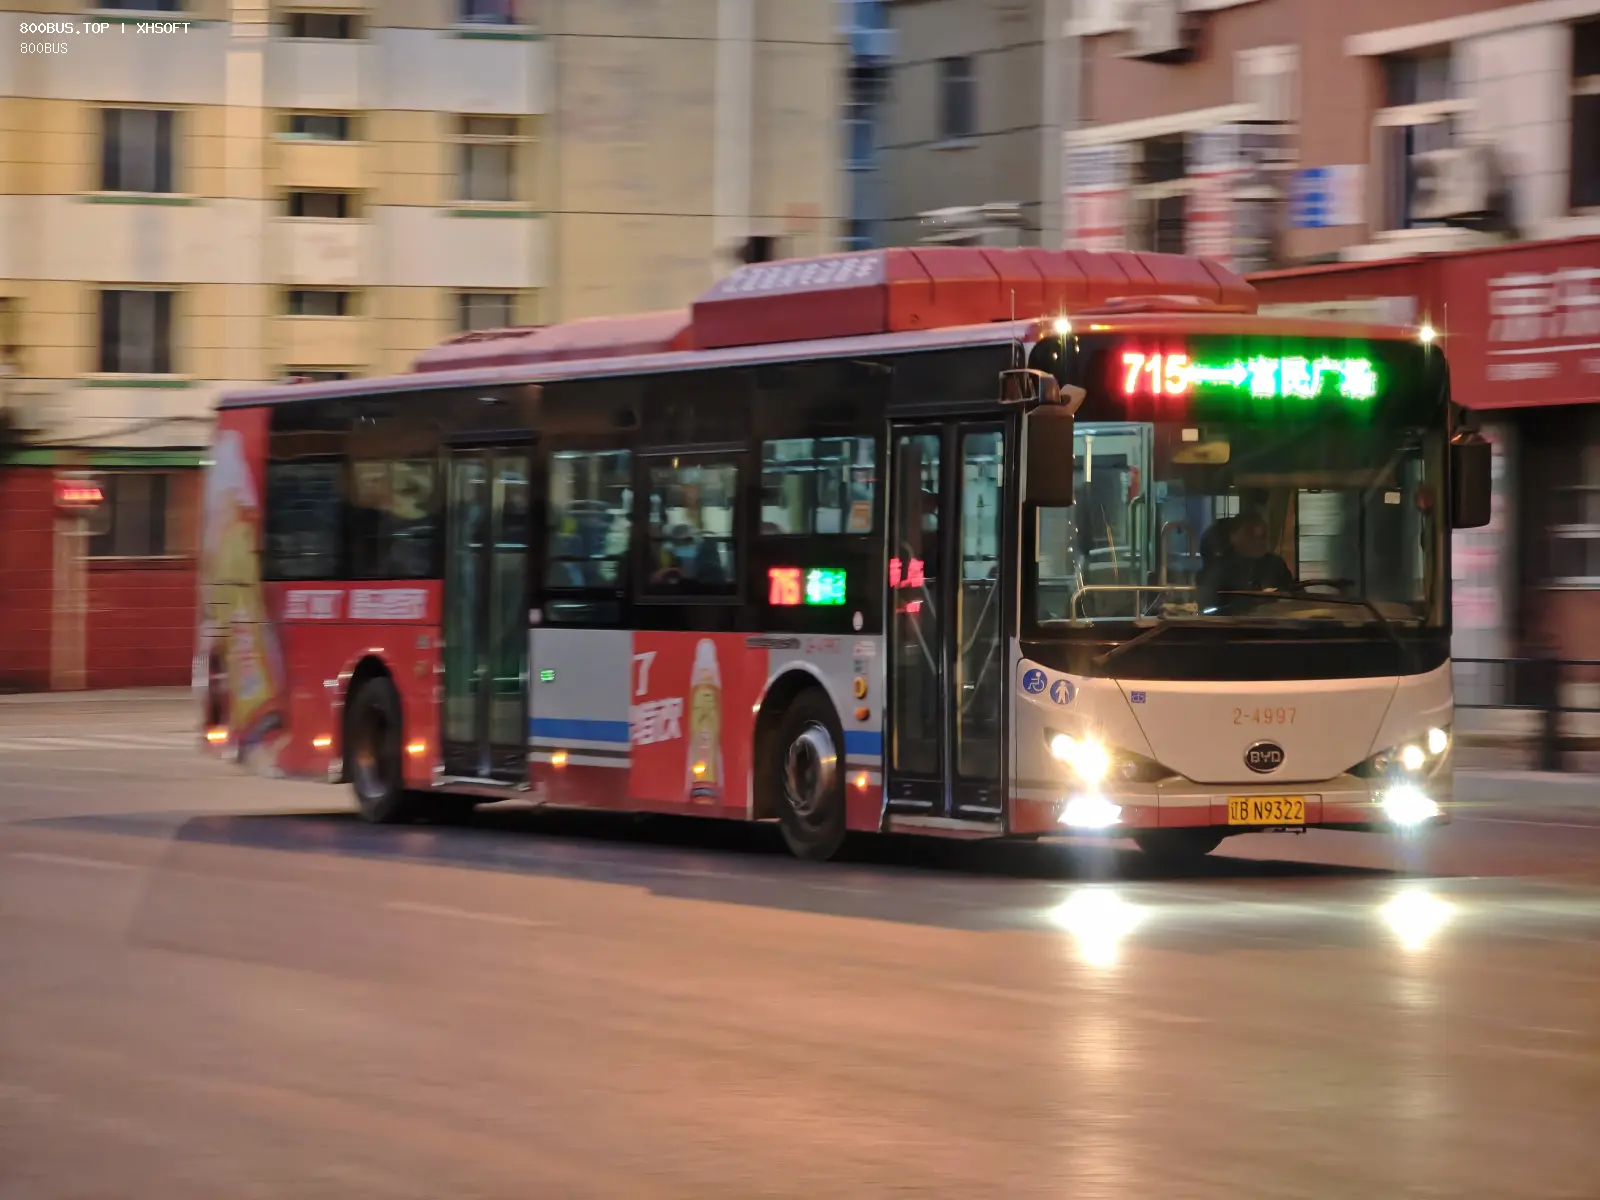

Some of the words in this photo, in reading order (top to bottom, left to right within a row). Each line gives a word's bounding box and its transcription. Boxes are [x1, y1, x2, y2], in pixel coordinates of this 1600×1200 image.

[1122, 353, 1188, 394] 715
[1232, 707, 1297, 725] 2-4997
[1249, 751, 1281, 763] BYD
